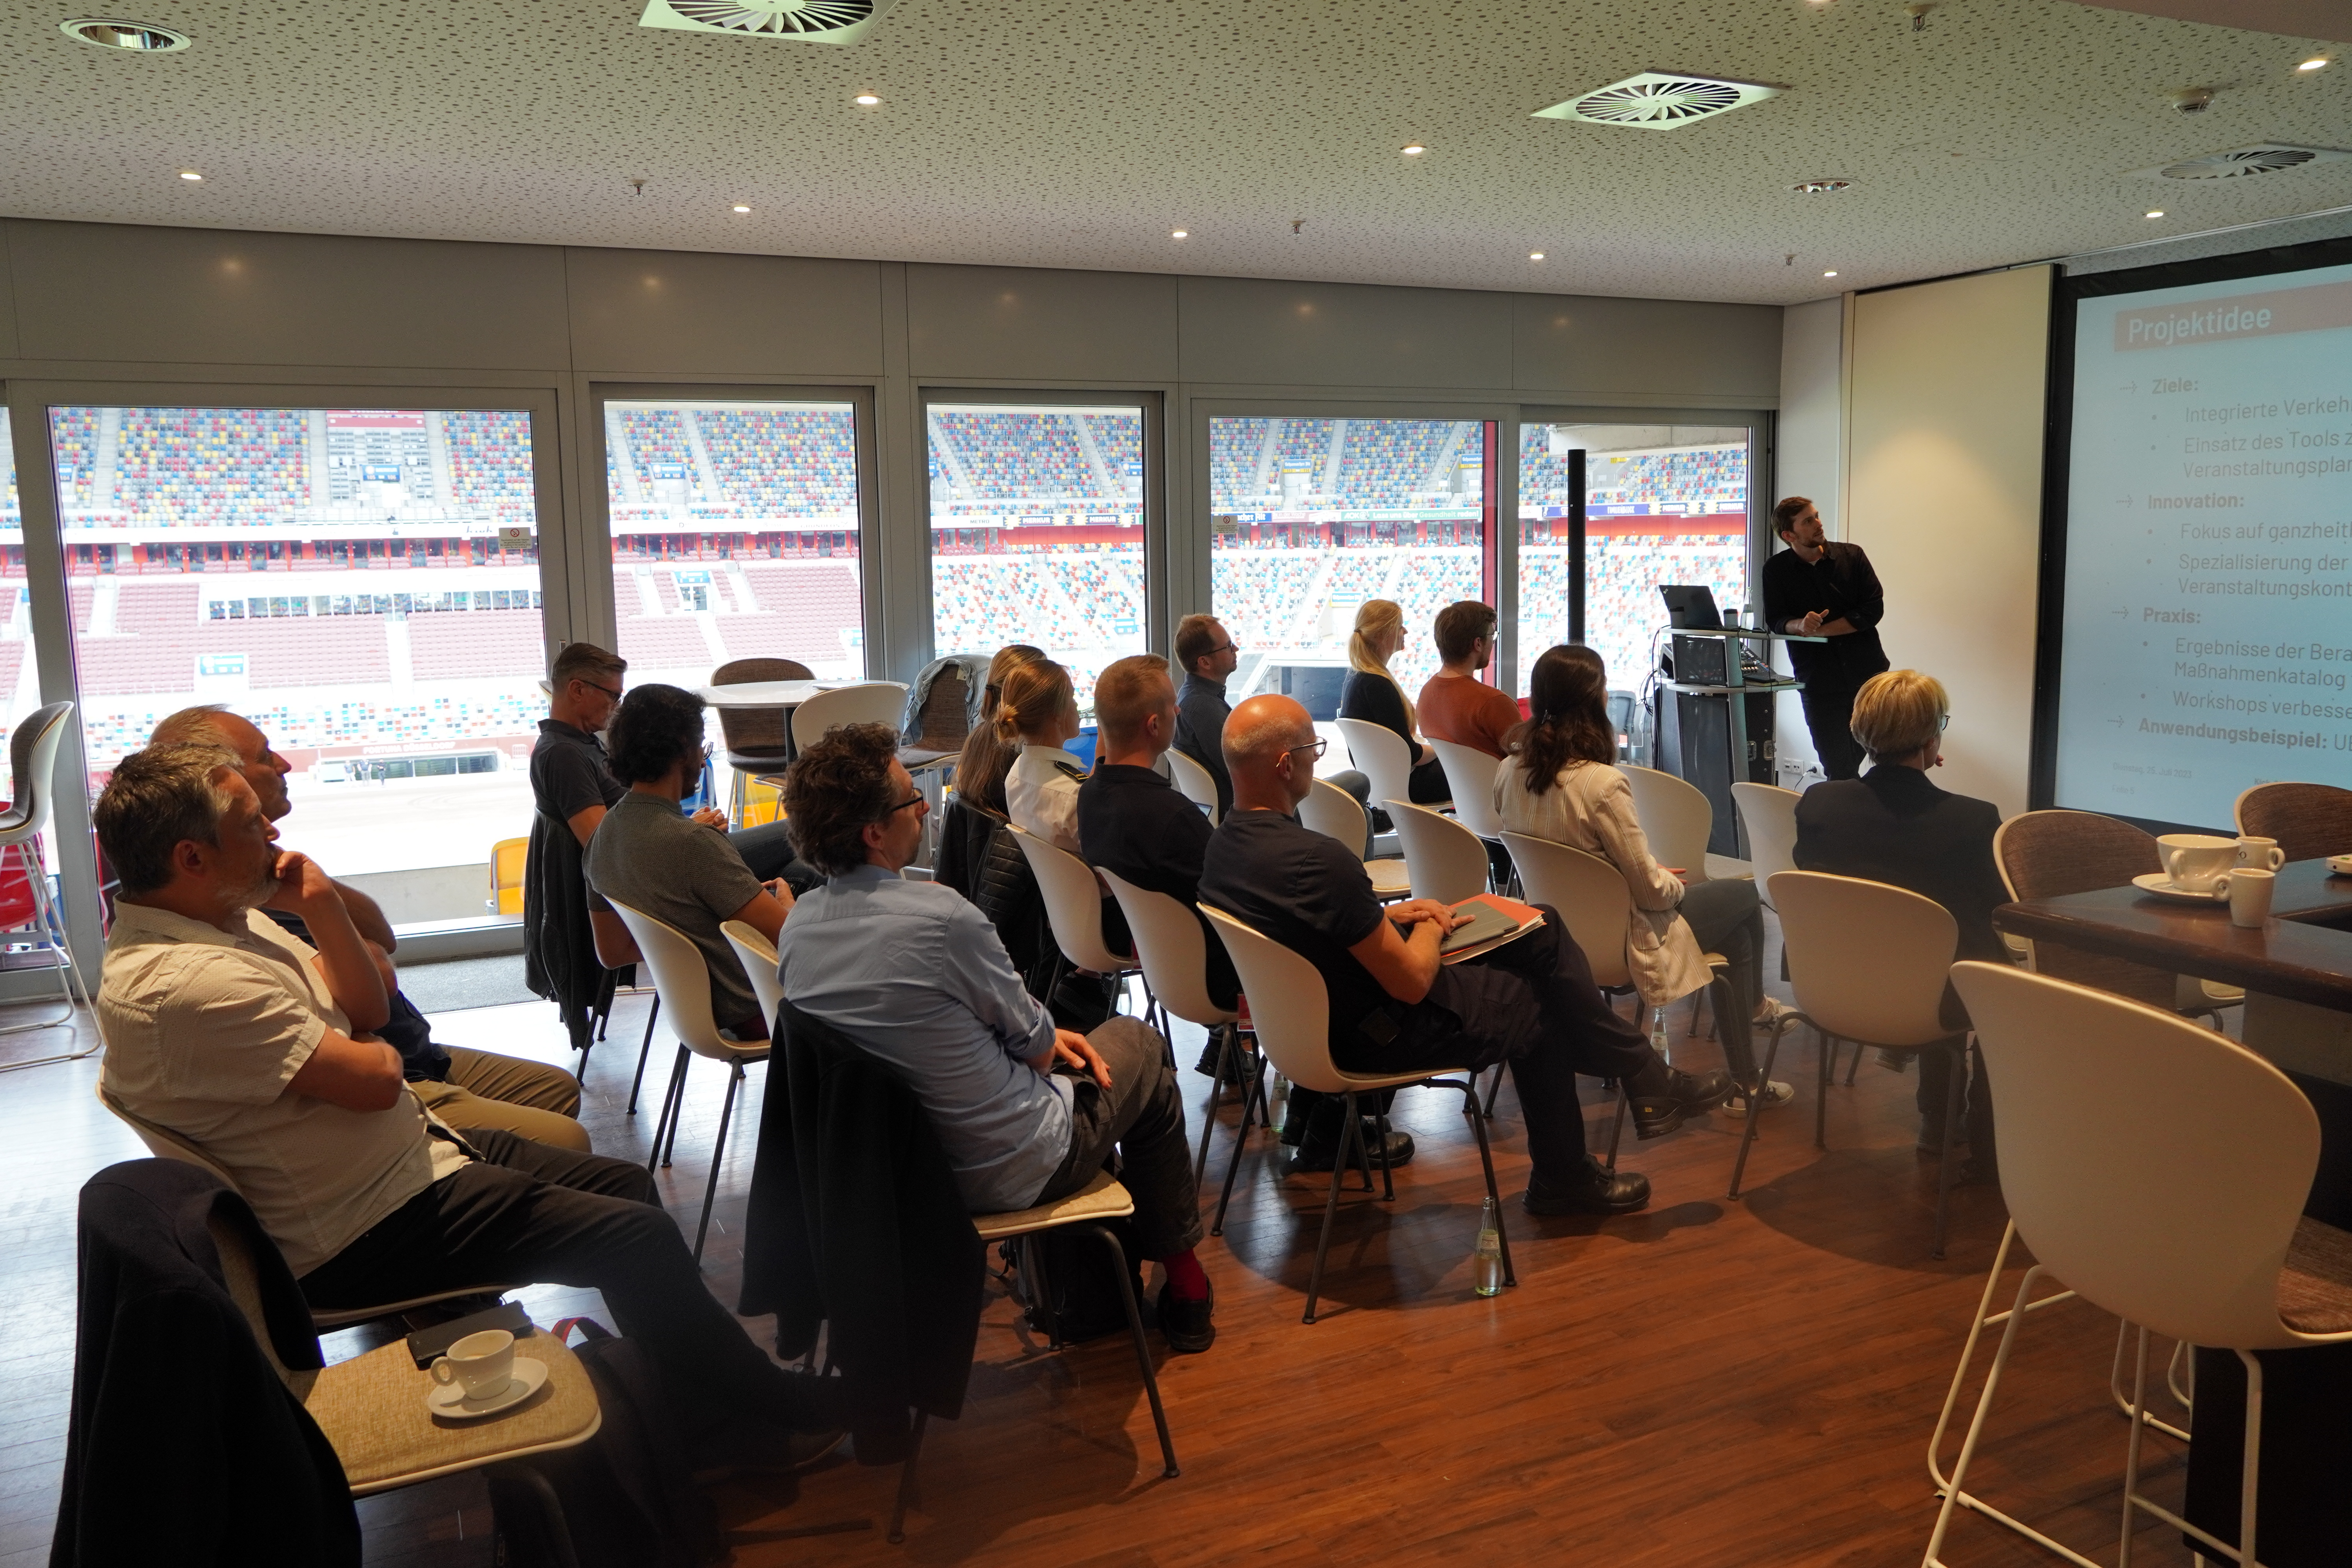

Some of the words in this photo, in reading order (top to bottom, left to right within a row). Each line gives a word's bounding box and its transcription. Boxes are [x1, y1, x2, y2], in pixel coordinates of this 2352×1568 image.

[2129, 306, 2271, 345] Projektidee
[2152, 376, 2198, 394] Ziele:
[2185, 403, 2278, 424] Integrierte
[2283, 395, 2352, 416] Verkeh
[2185, 436, 2247, 454] Einsatz
[2252, 433, 2283, 450] des
[2289, 430, 2339, 448] Tools
[2148, 493, 2244, 509] Innovation:
[2181, 523, 2231, 539] Fokus
[2236, 522, 2264, 539] auf
[2179, 553, 2312, 575] Spezialisierung
[2317, 554, 2348, 571] der
[2143, 607, 2201, 624] Praxis:
[2175, 637, 2270, 657] Ergebnisse
[2275, 642, 2305, 659] der
[2174, 661, 2346, 691] Maßnahmenkatalog
[2172, 690, 2267, 715] Workshops
[2139, 717, 2327, 749] Anwendungsbeispiel:
[2173, 769, 2192, 779] 2023
